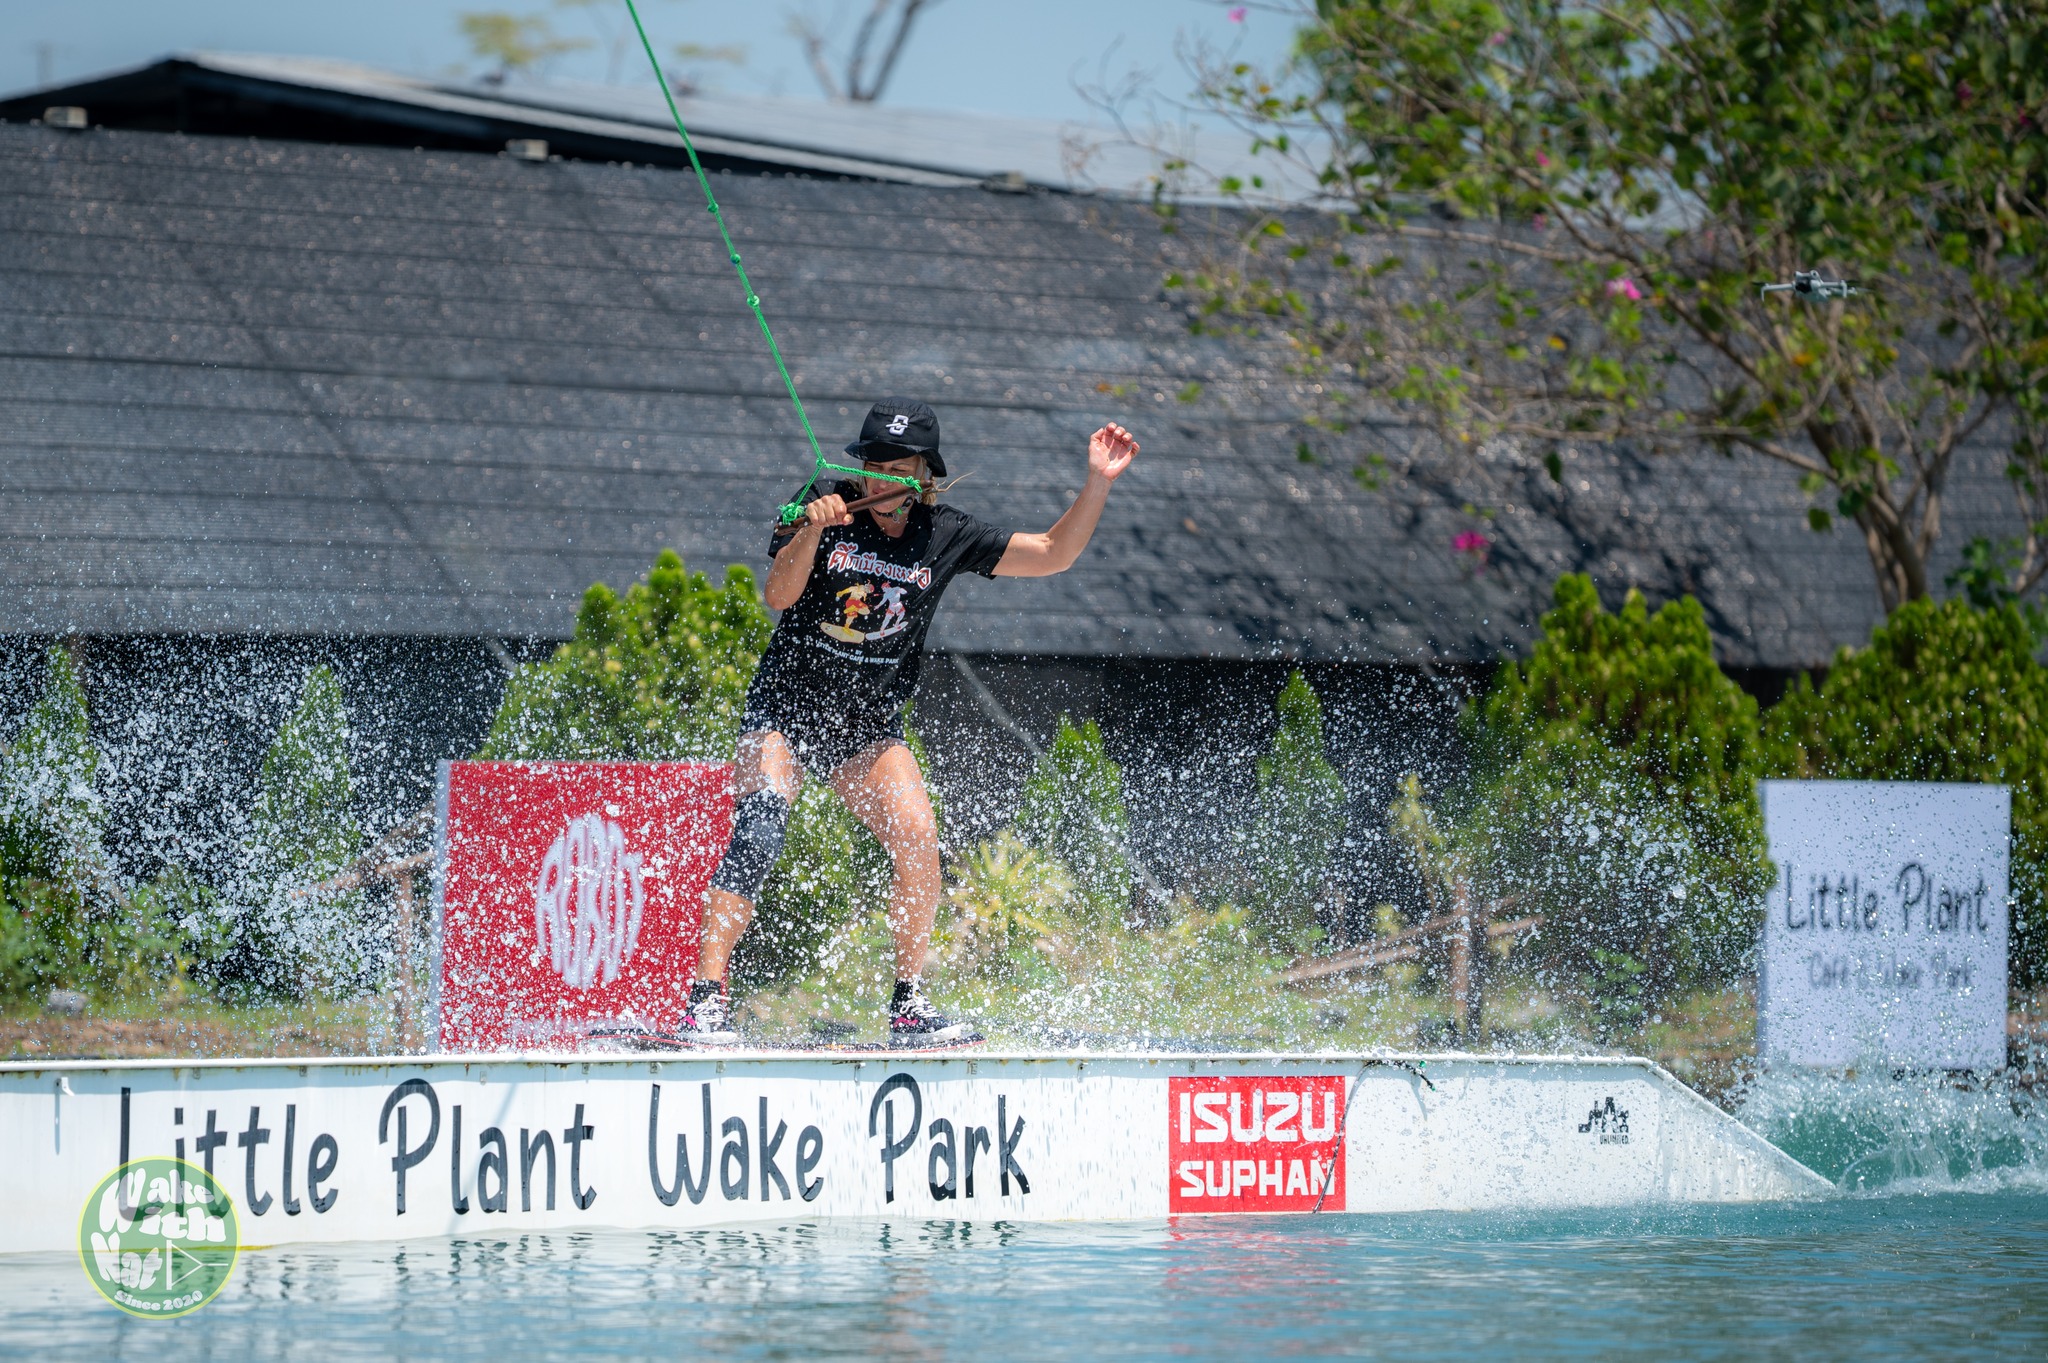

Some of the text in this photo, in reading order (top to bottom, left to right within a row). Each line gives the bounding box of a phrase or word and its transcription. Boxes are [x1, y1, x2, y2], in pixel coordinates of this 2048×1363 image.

[1786, 860, 1989, 932] Little Plant
[119, 1073, 1031, 1221] Little Plant Wake Park
[1180, 1091, 1335, 1143] ISUZU
[1180, 1160, 1335, 1197] SUPHAN
